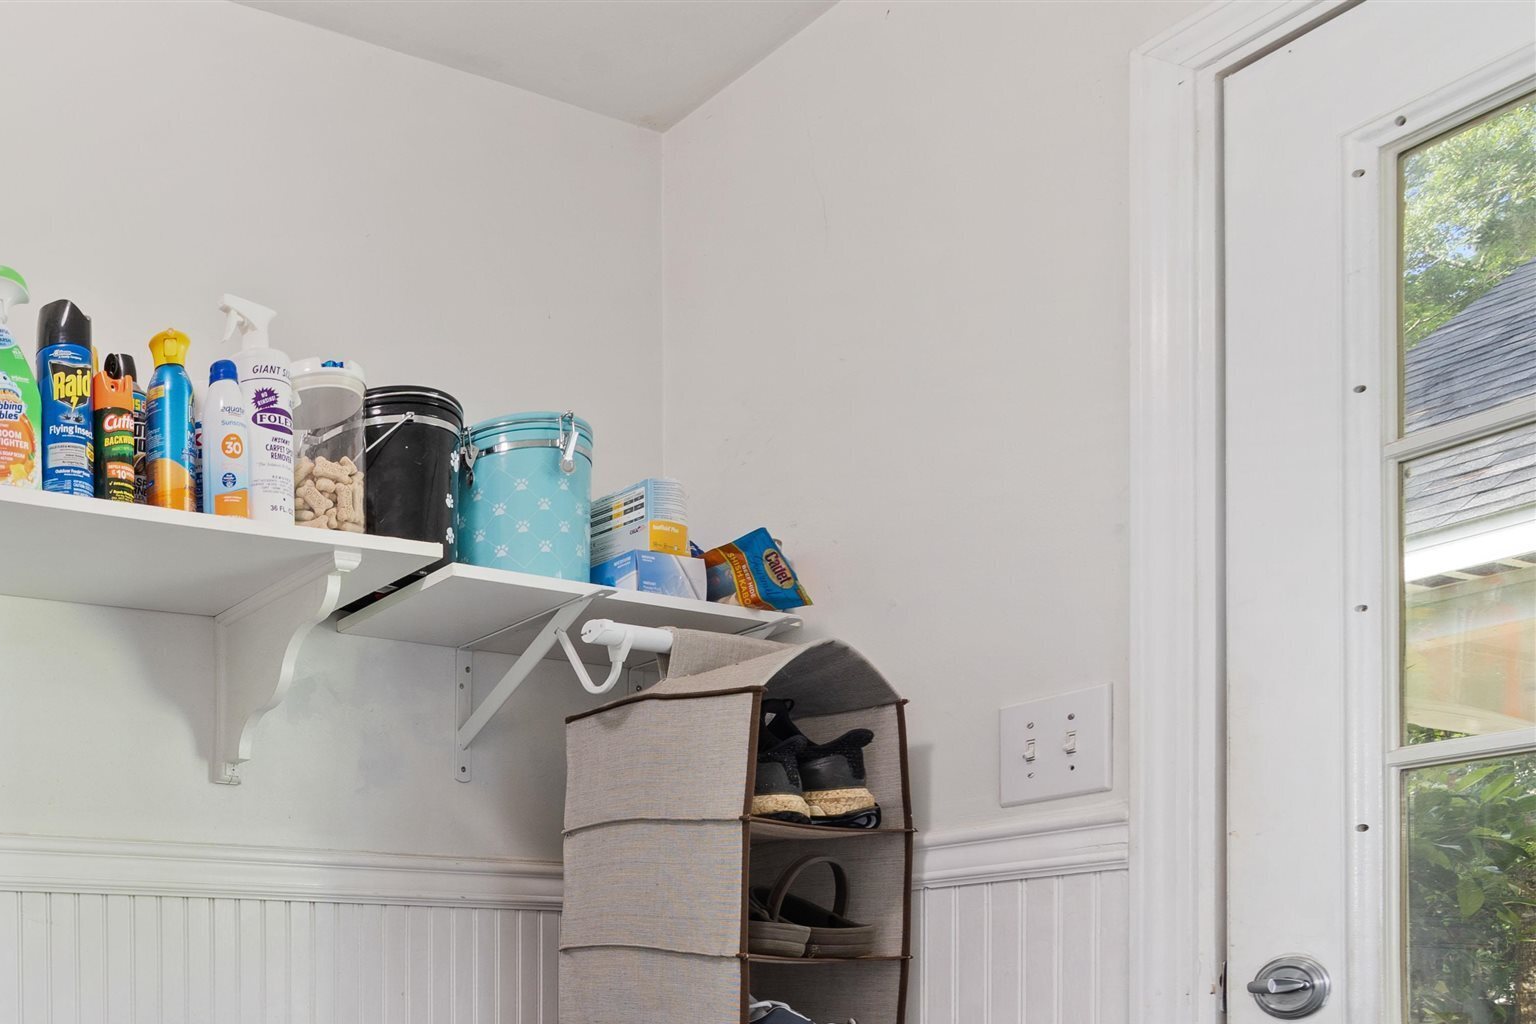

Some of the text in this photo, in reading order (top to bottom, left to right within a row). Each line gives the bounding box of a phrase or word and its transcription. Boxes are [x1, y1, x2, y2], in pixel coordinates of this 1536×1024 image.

[252, 364, 280, 375] GIANT
[53, 369, 91, 401] Raid
[104, 413, 134, 430] Cutte
[49, 424, 74, 436] Flying
[225, 441, 242, 455] 30
[265, 443, 285, 453] CARPET
[272, 436, 290, 446] INSTANT
[116, 469, 127, 479] 10
[727, 552, 744, 578] SHISH
[764, 551, 792, 585] Cadet
[741, 564, 756, 598] BEEF HIDE
